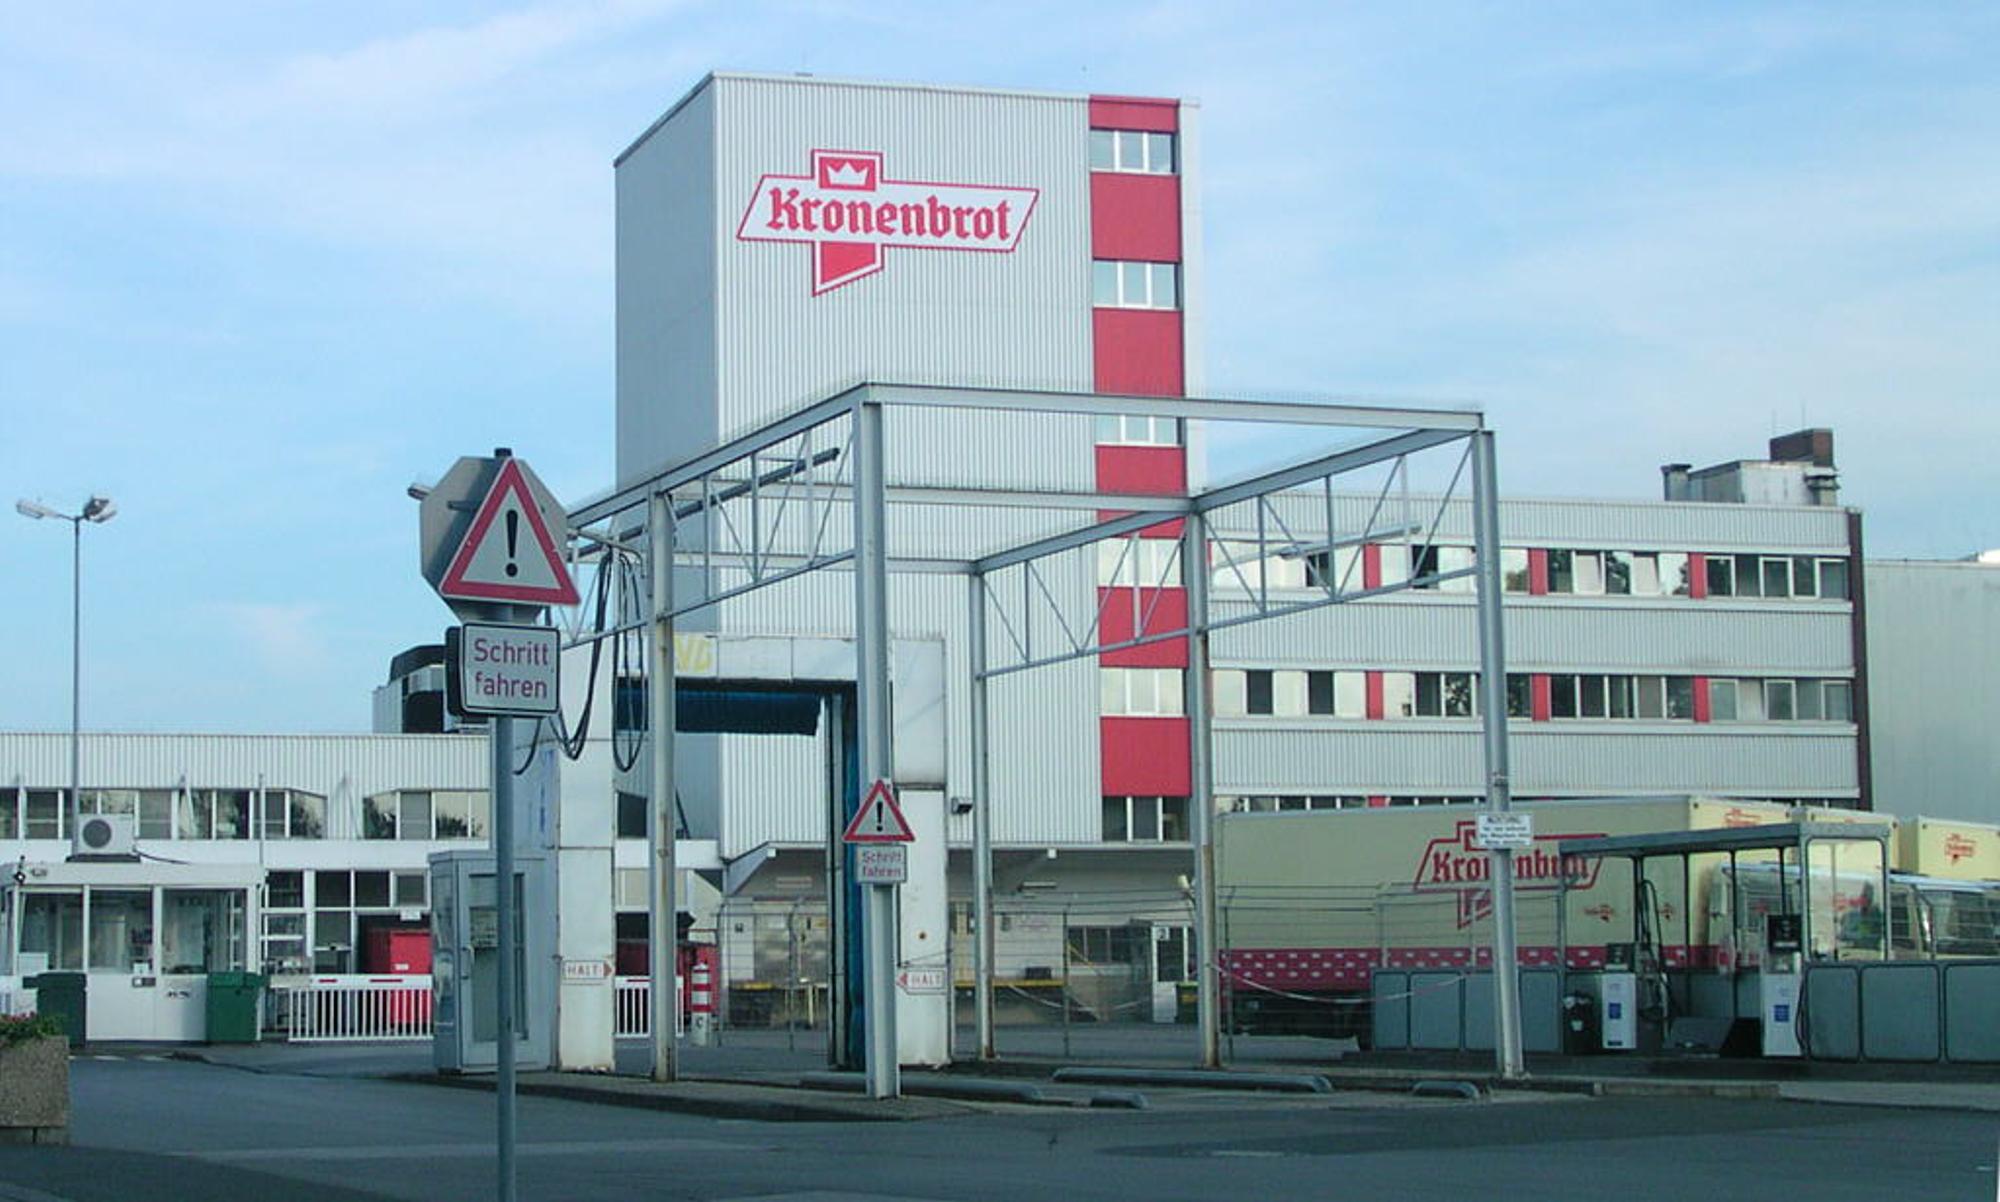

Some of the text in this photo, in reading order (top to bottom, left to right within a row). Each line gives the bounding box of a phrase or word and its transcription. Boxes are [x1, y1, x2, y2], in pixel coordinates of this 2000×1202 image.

[766, 186, 1011, 241] Kronenbrot
[474, 637, 549, 666] Schritt
[475, 670, 548, 699] fahren
[862, 850, 902, 864] Schritt
[862, 865, 902, 878] fahren
[1431, 849, 1589, 883] Kronbrot
[910, 970, 942, 985] HALT
